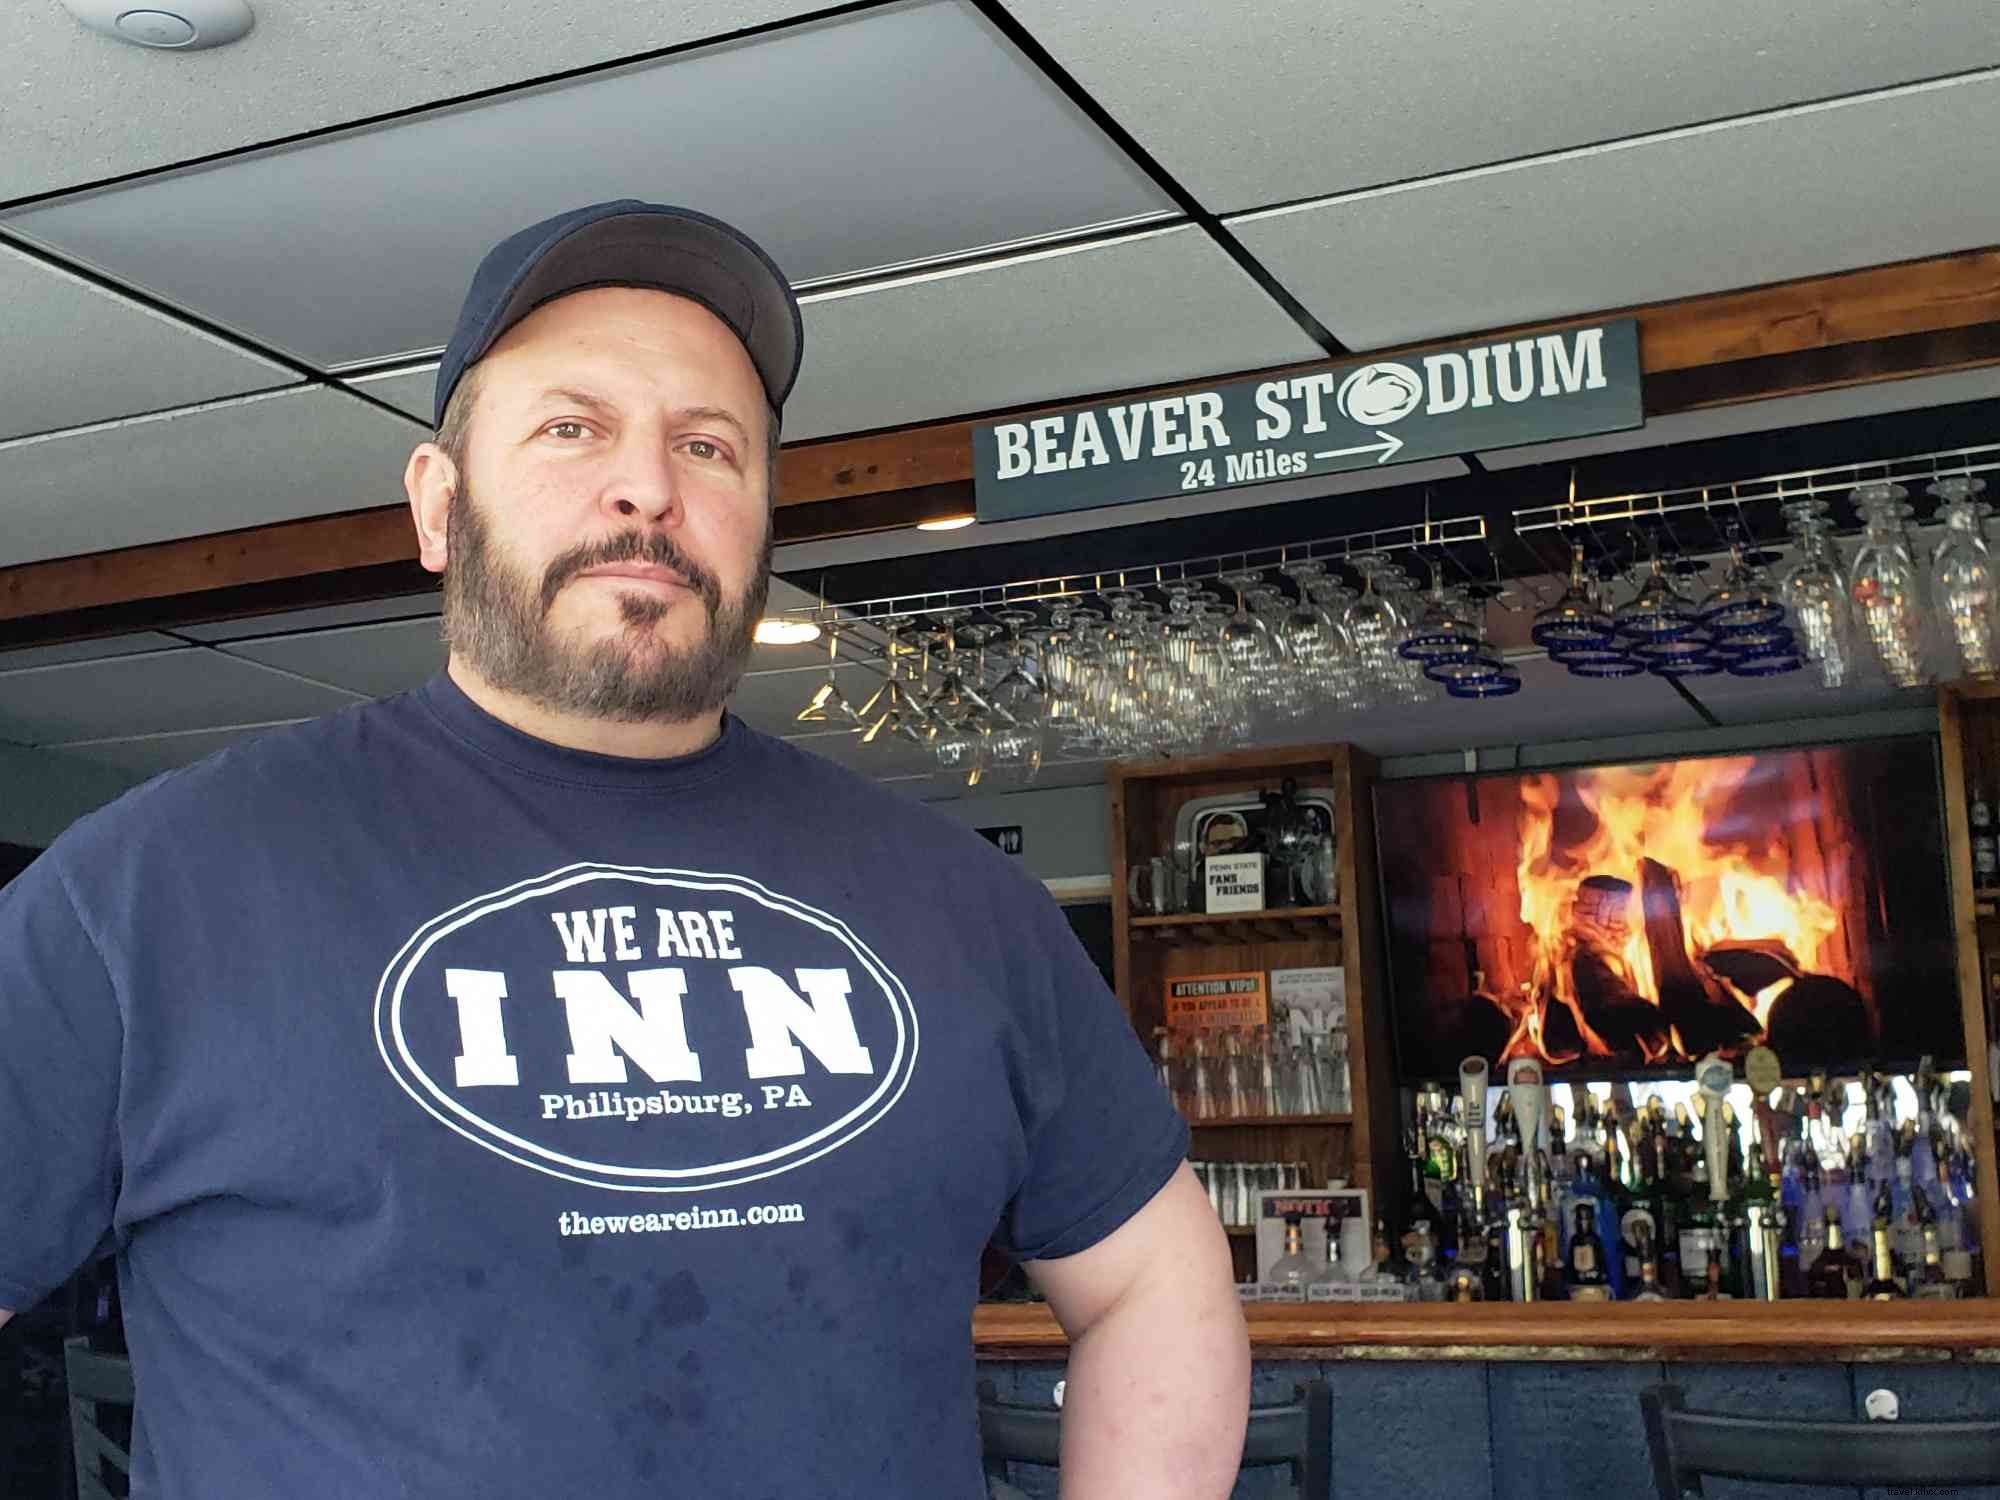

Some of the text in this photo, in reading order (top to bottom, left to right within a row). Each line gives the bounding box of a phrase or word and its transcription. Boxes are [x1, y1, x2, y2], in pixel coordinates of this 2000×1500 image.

[994, 328, 1607, 480] BEAVER STDIUM
[1180, 448, 1307, 490] 24 Miles
[1216, 883, 1259, 896] FRIENDS
[552, 905, 743, 963] WE ARE
[1176, 981, 1226, 996] ATTENTION
[445, 966, 874, 1087] INN
[540, 1084, 812, 1122] Philipsburg, PA
[558, 1203, 805, 1236] theweareinn.com
